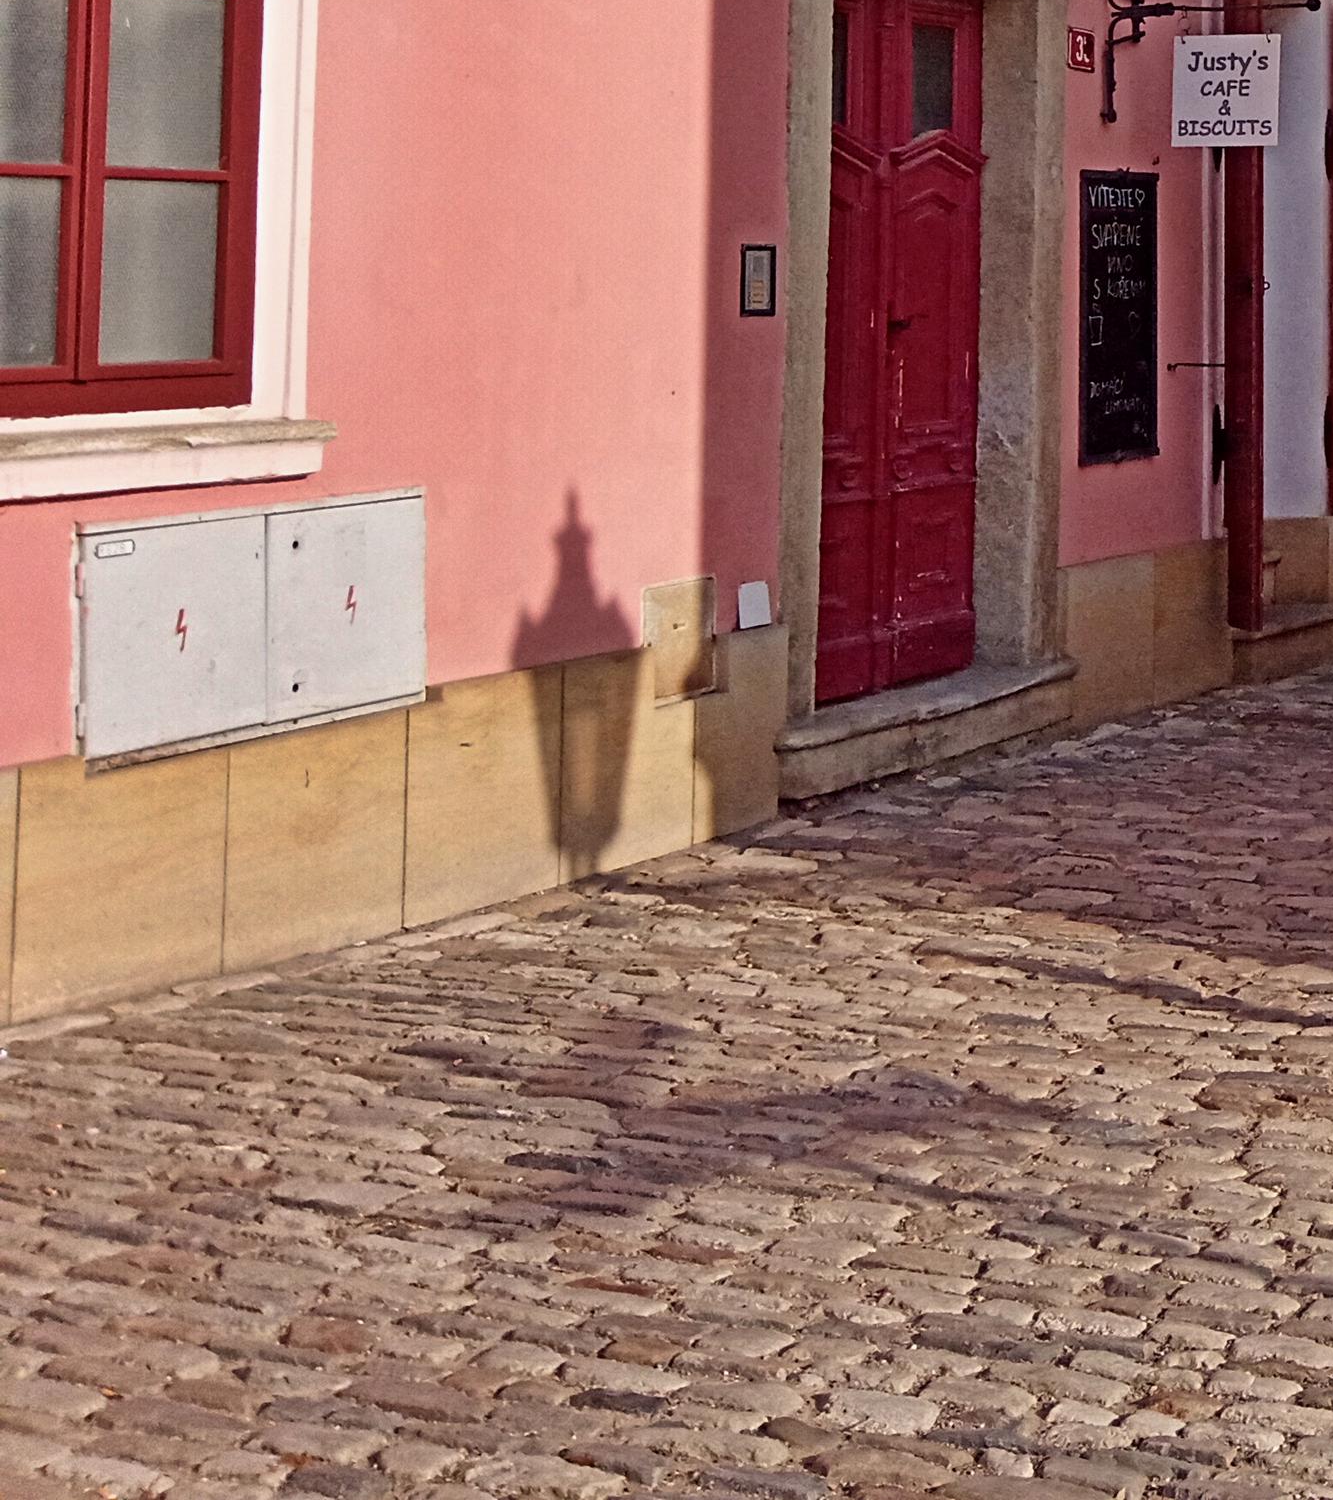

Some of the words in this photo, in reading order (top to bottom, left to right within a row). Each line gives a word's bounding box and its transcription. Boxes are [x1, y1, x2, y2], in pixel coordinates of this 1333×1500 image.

[1187, 50, 1269, 76] Justy's
[1199, 79, 1251, 97] CAFE
[1218, 100, 1231, 116] &
[1177, 119, 1273, 137] BISCUITS
